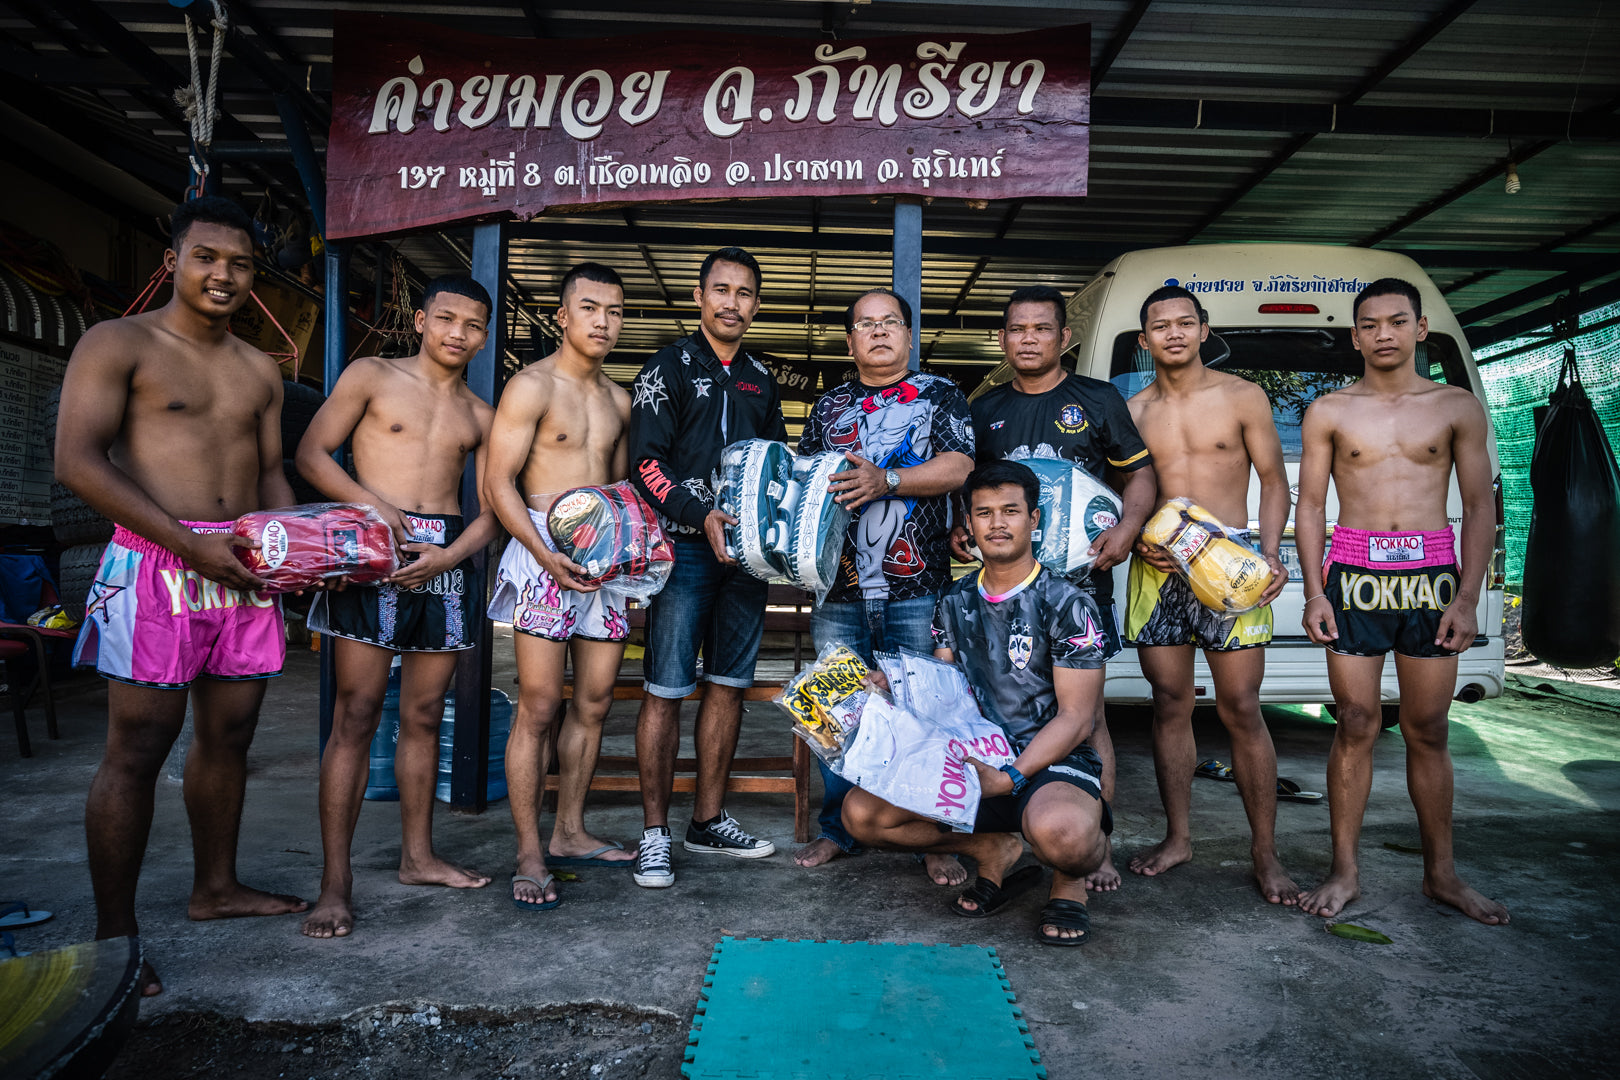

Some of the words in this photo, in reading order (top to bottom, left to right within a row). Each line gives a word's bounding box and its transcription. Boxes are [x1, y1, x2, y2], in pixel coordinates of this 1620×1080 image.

[368, 55, 671, 140] ค่ายมวย
[398, 166, 446, 189] 137
[459, 152, 515, 196] หมู่ที่
[523, 162, 542, 187] 8
[638, 458, 678, 504] YOKKAO
[745, 449, 764, 542] YOKKAO
[802, 460, 835, 549] YOKKAO
[267, 524, 280, 563] YOKKAO
[1374, 537, 1420, 551] YOKKAO
[1340, 572, 1456, 612] YOKKAO
